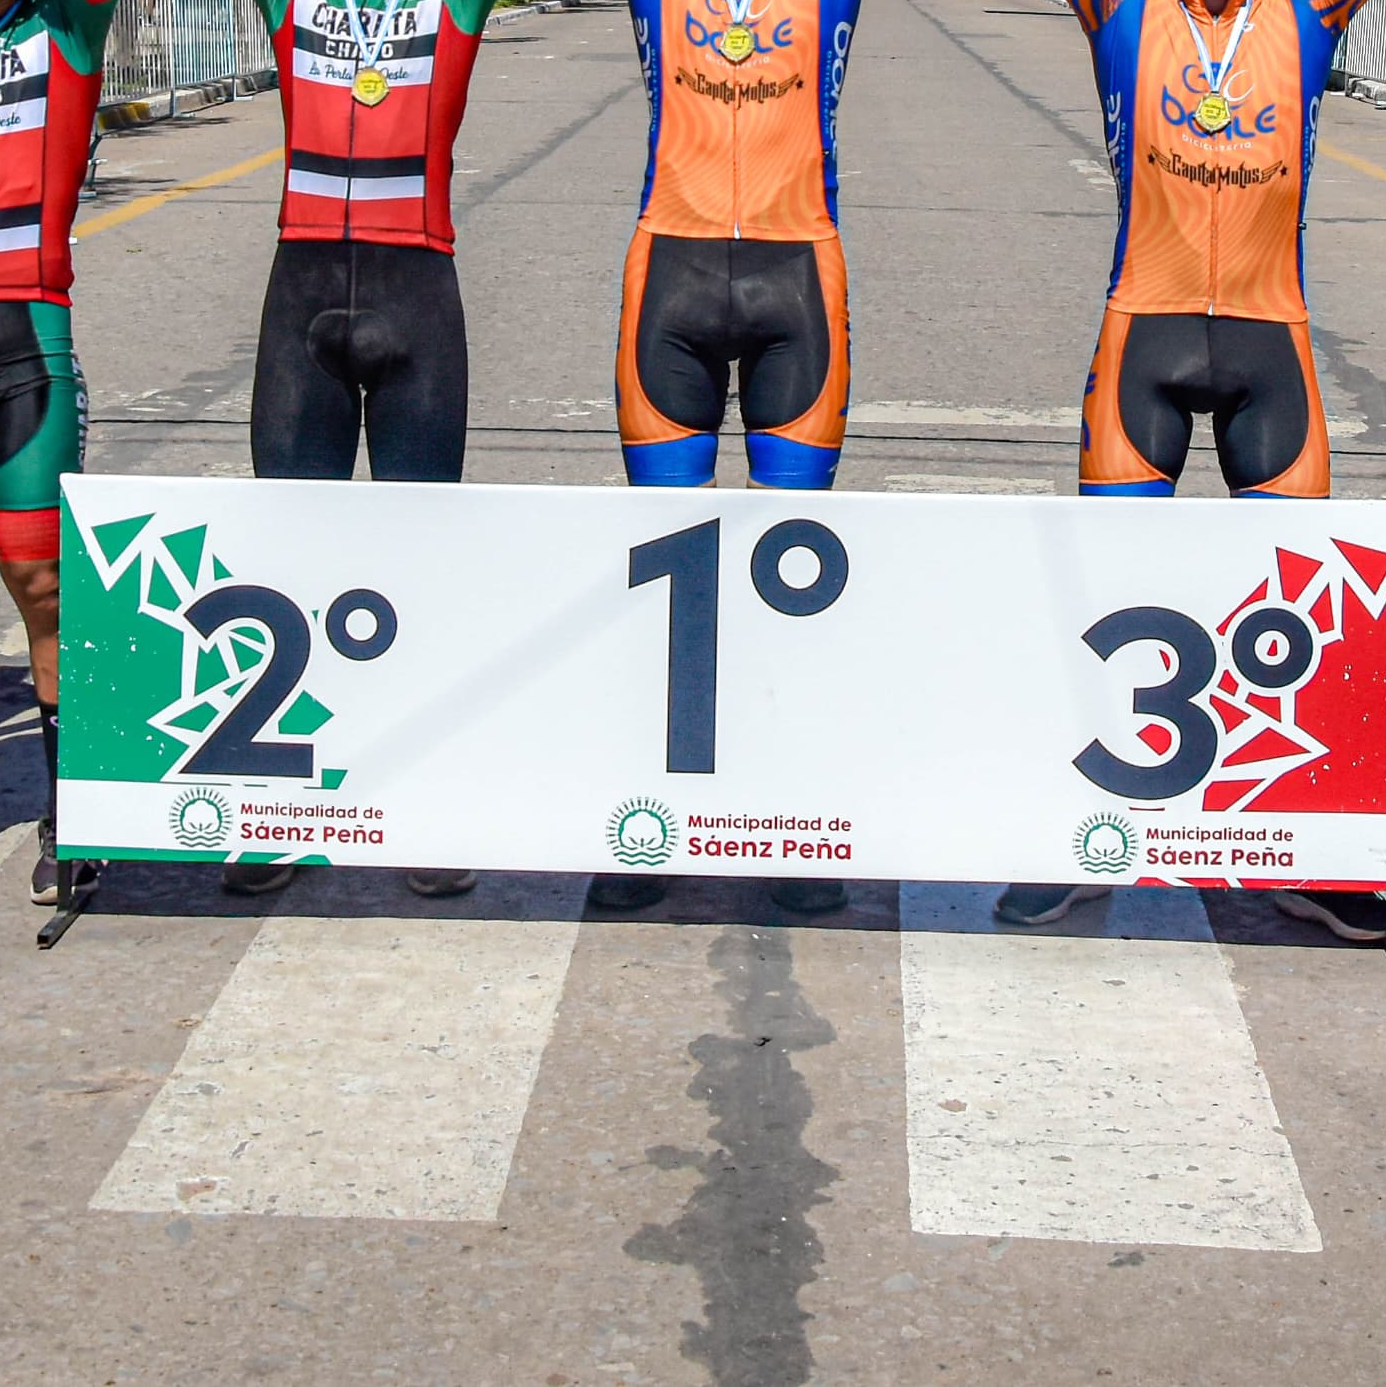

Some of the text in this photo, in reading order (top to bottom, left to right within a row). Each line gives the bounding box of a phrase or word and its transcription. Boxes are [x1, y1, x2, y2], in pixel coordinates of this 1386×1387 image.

[240, 802, 384, 820] Municipalidad de
[240, 821, 384, 845] Sáenz Peña
[687, 814, 852, 832] Municipalidad de
[1146, 826, 1294, 843] Municipalidad de
[687, 834, 852, 860] Sáenz Peña
[1146, 845, 1294, 868] Sáenz Peña
